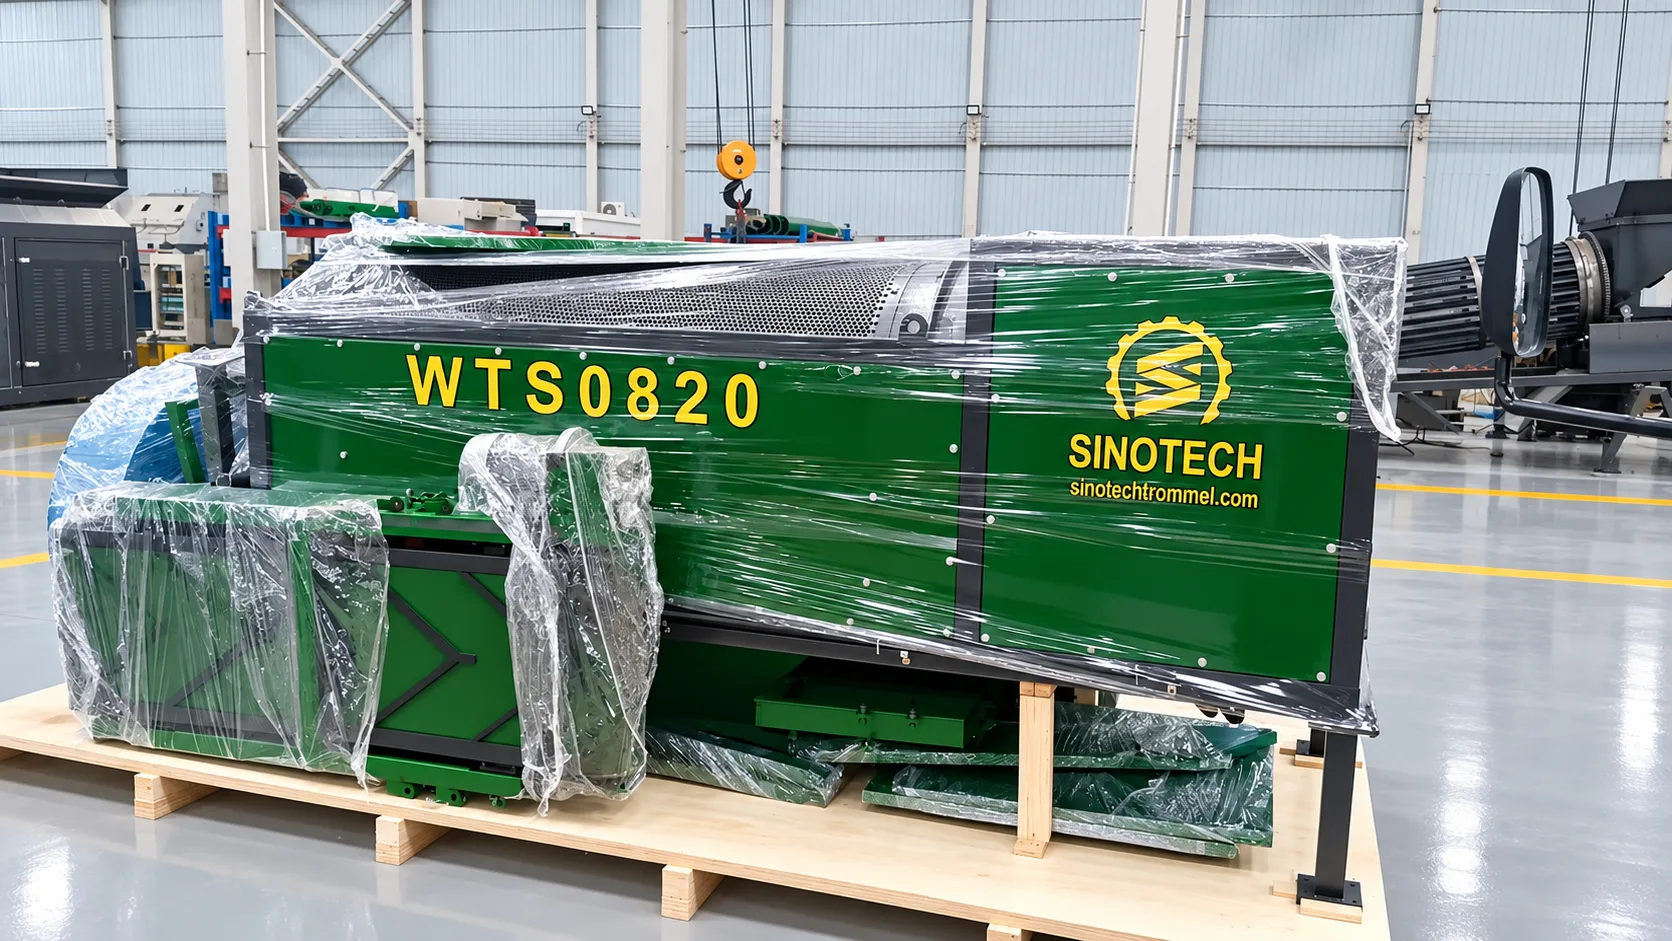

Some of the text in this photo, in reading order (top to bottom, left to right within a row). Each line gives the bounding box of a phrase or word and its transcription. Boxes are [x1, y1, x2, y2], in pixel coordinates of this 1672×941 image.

[406, 354, 759, 428] WTS0820
[1068, 433, 1264, 480] SINOTECH
[1069, 478, 1259, 509] sinotechtrommel.com
